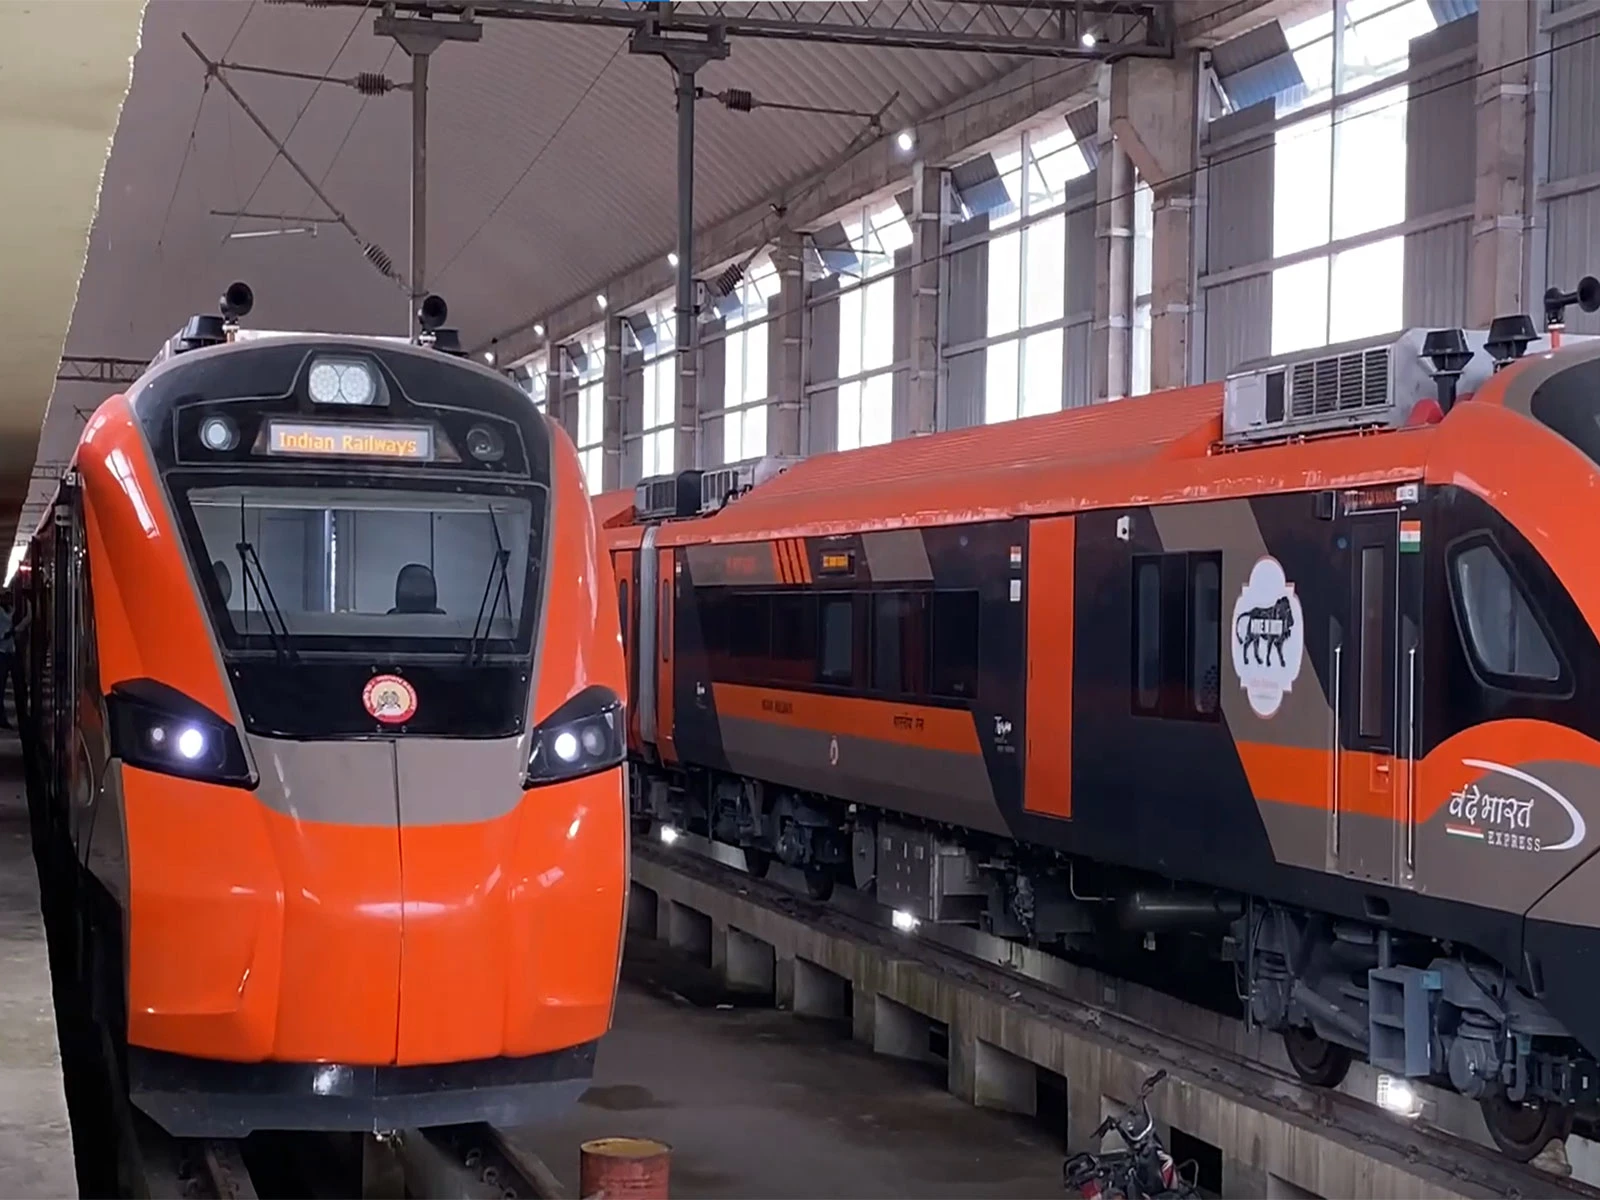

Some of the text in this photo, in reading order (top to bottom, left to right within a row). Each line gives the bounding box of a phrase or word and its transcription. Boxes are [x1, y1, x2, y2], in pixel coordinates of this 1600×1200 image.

[279, 432, 417, 456] Indian Railways
[1487, 830, 1541, 852] EXPRESS
